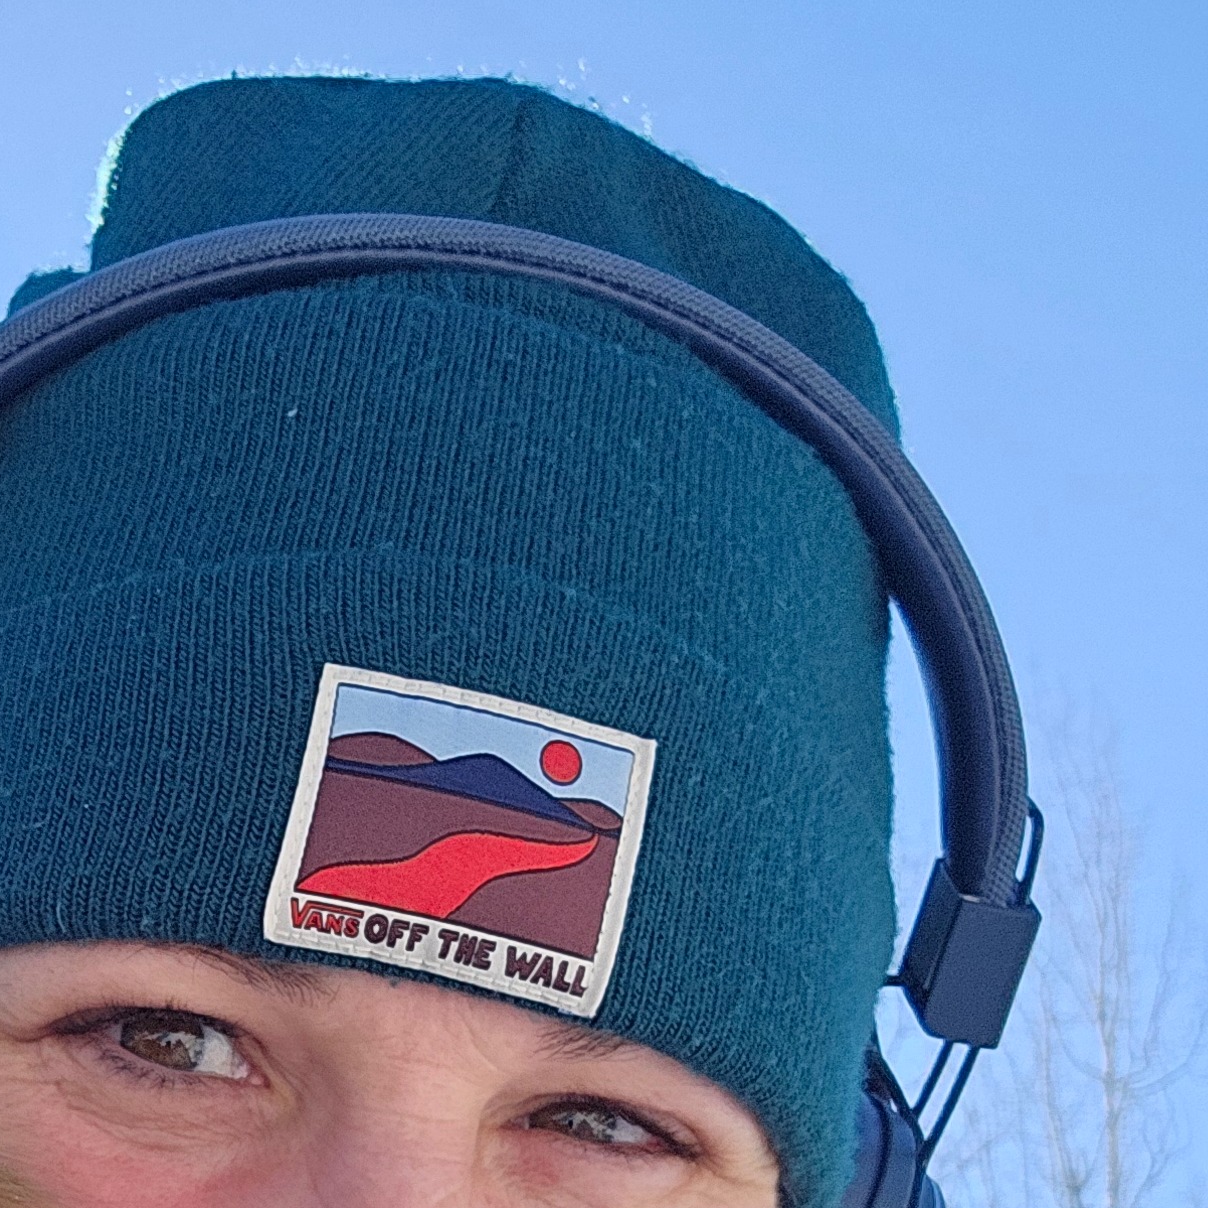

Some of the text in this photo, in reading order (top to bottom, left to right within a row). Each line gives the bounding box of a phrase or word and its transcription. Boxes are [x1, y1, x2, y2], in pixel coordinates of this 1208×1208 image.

[291, 897, 589, 997] VANS OFF THE WALL
